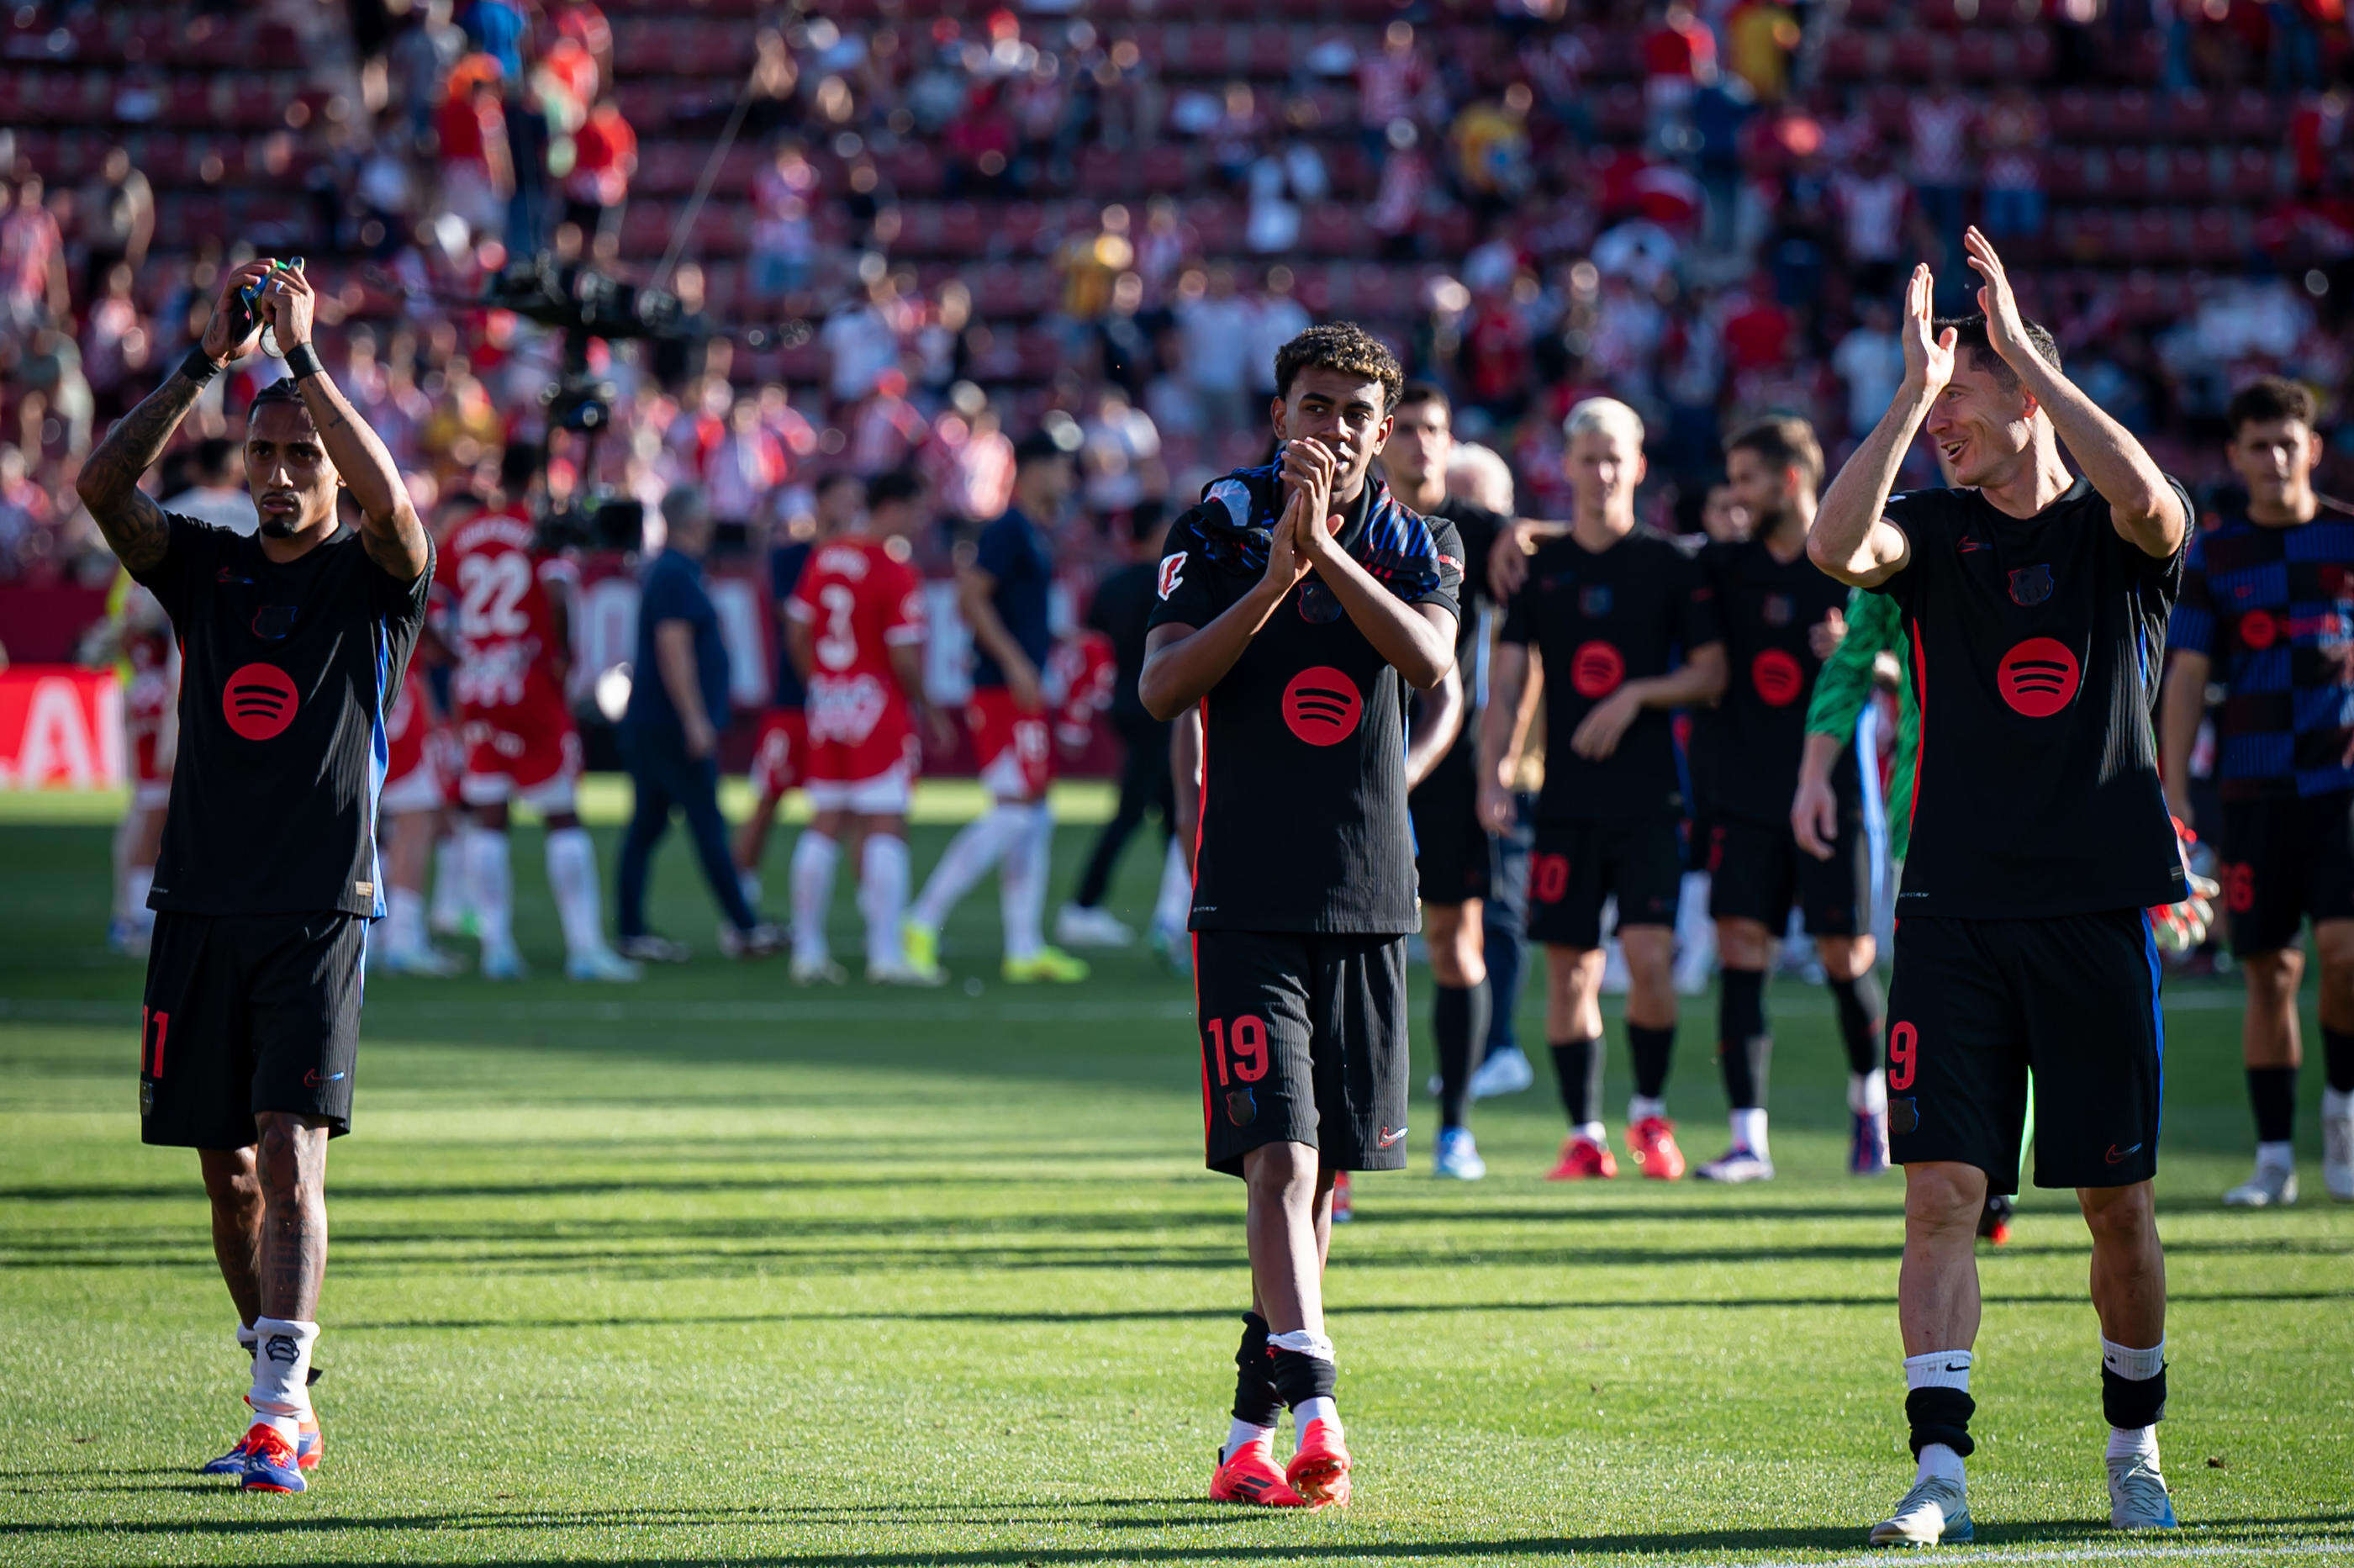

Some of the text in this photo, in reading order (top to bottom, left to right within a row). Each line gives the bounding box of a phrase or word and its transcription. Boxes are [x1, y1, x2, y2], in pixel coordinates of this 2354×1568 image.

[458, 550, 533, 636] 22
[816, 583, 858, 672] 3
[1208, 1015, 1269, 1086] 19
[1889, 1021, 1918, 1090] 9
